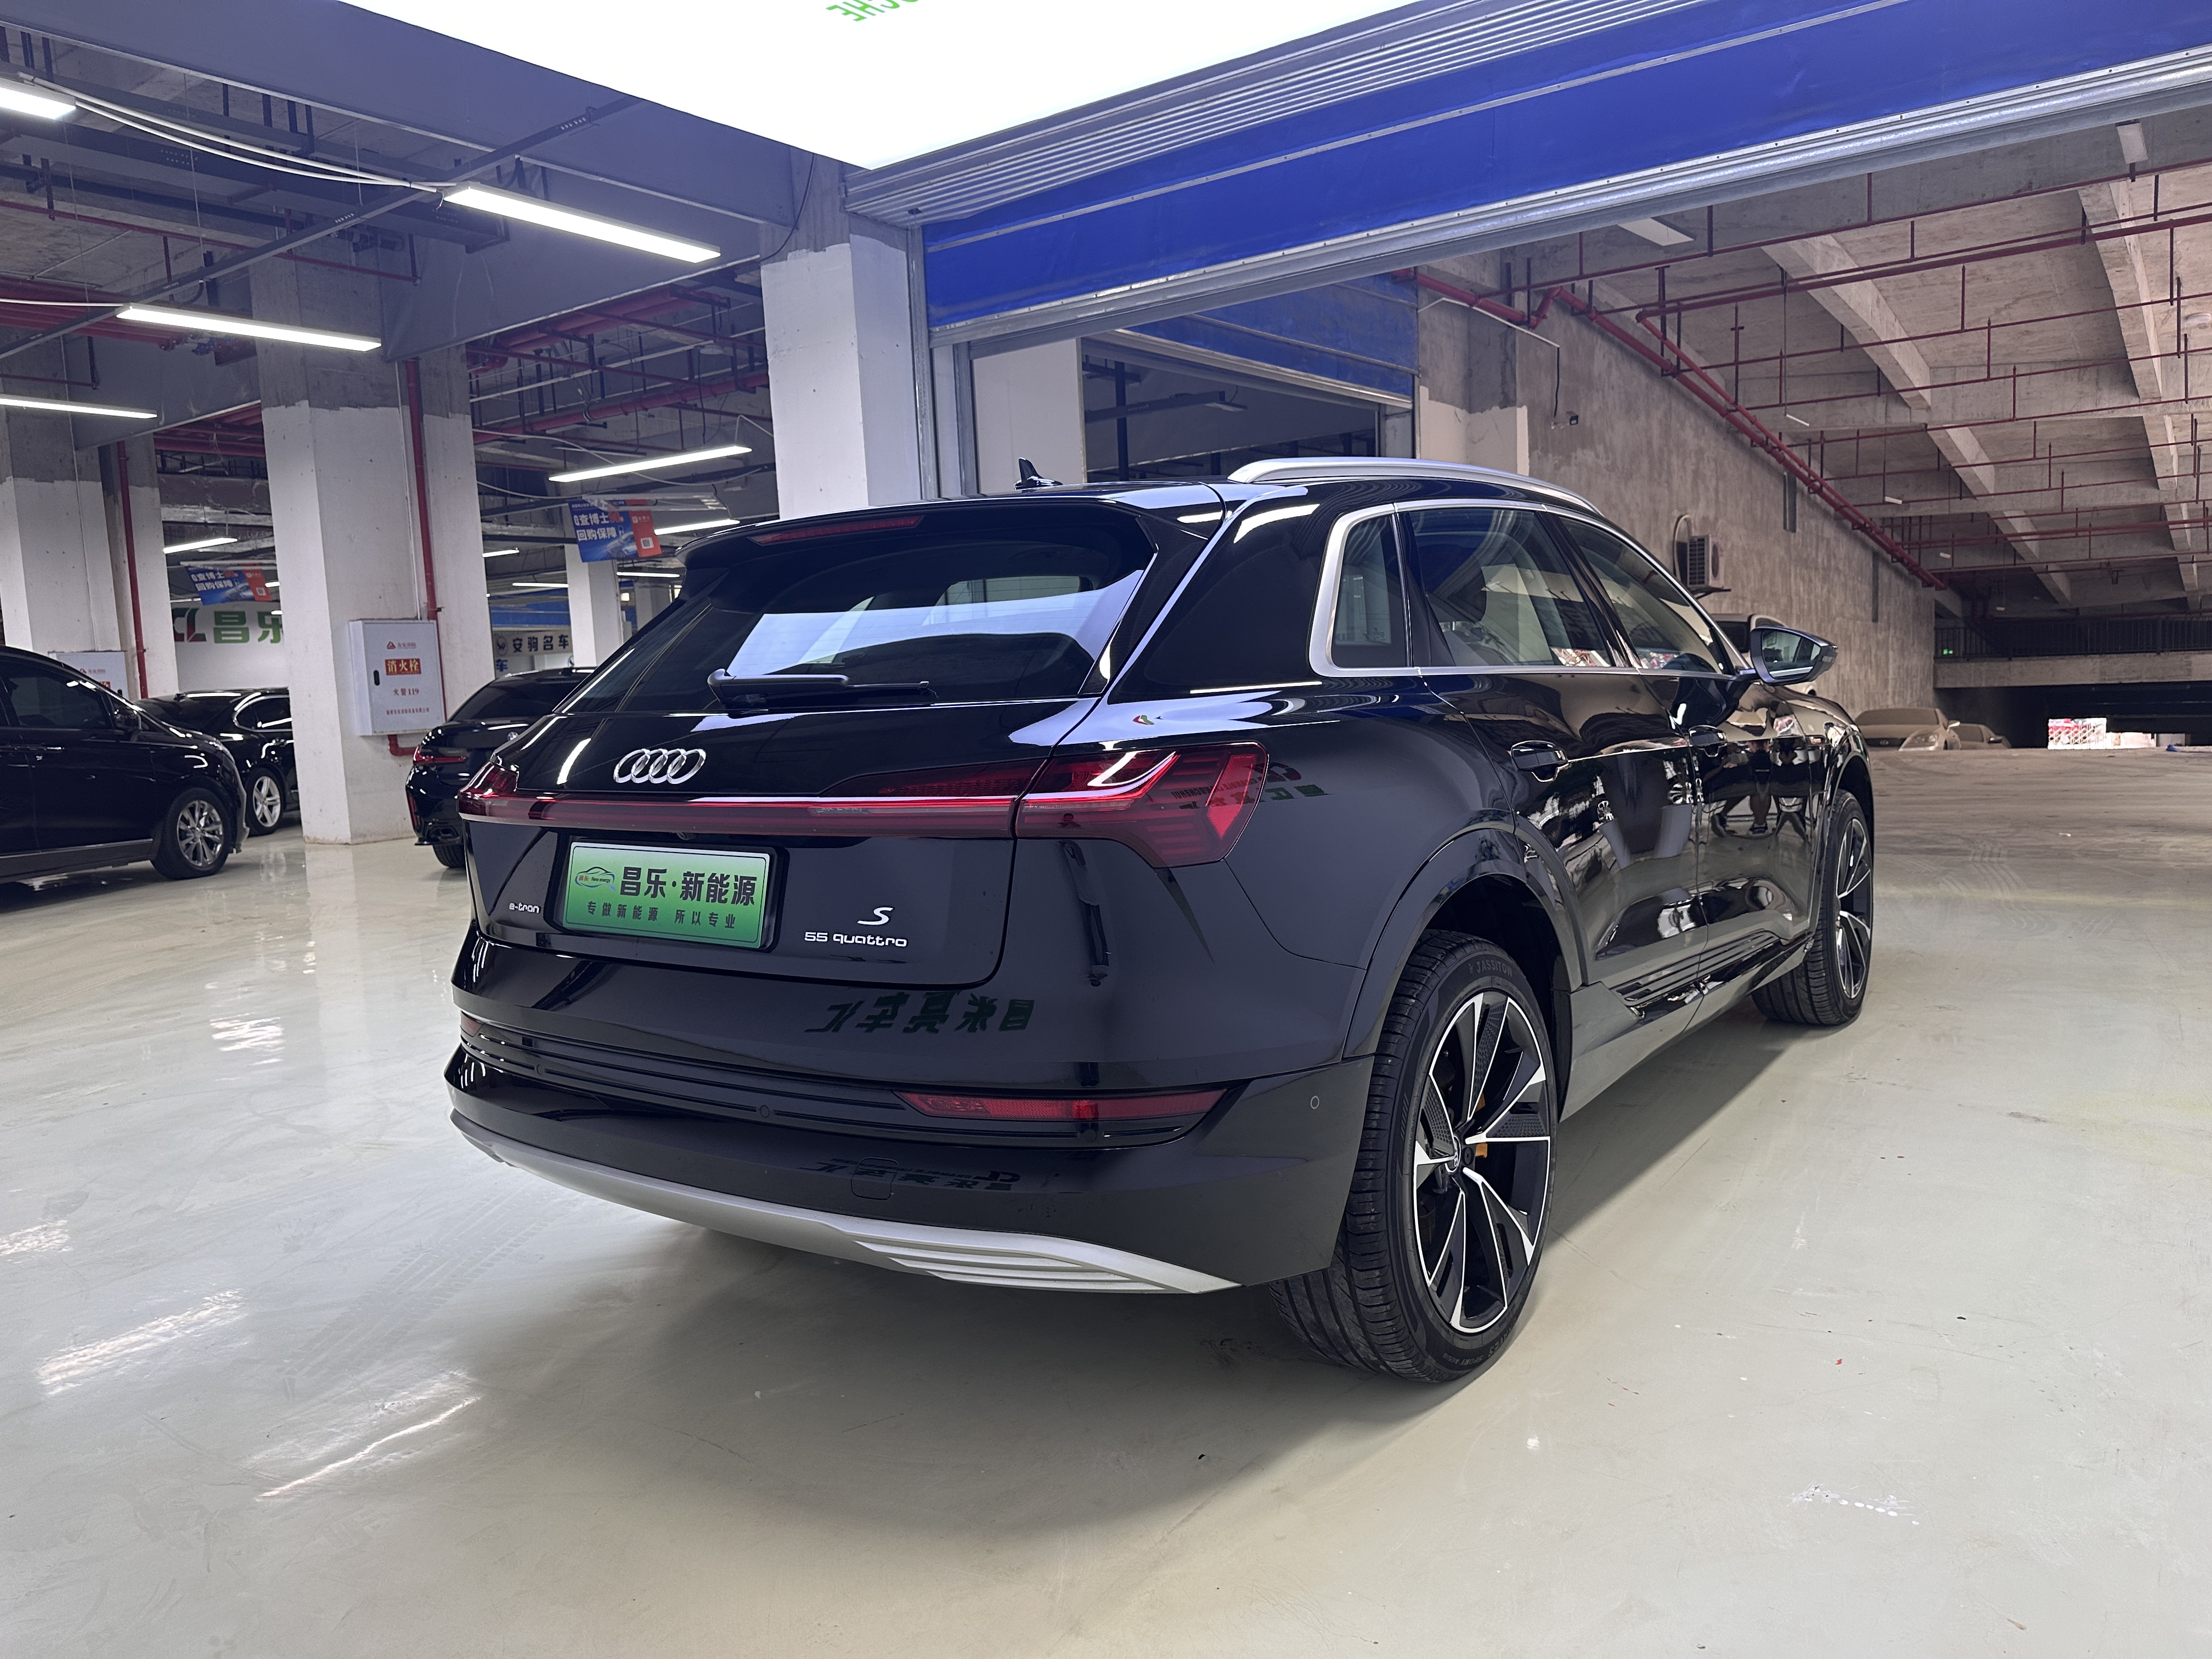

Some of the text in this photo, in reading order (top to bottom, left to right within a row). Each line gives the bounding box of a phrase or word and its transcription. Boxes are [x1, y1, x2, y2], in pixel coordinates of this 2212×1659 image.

[577, 527, 617, 541] 回购保障
[512, 634, 569, 653] 安驹名车
[387, 659, 419, 672] 消火栓
[509, 902, 539, 913] e-tron
[588, 901, 735, 928] 专做新能源 所以专业
[857, 907, 893, 926] S
[804, 932, 907, 947] 55 quattro
